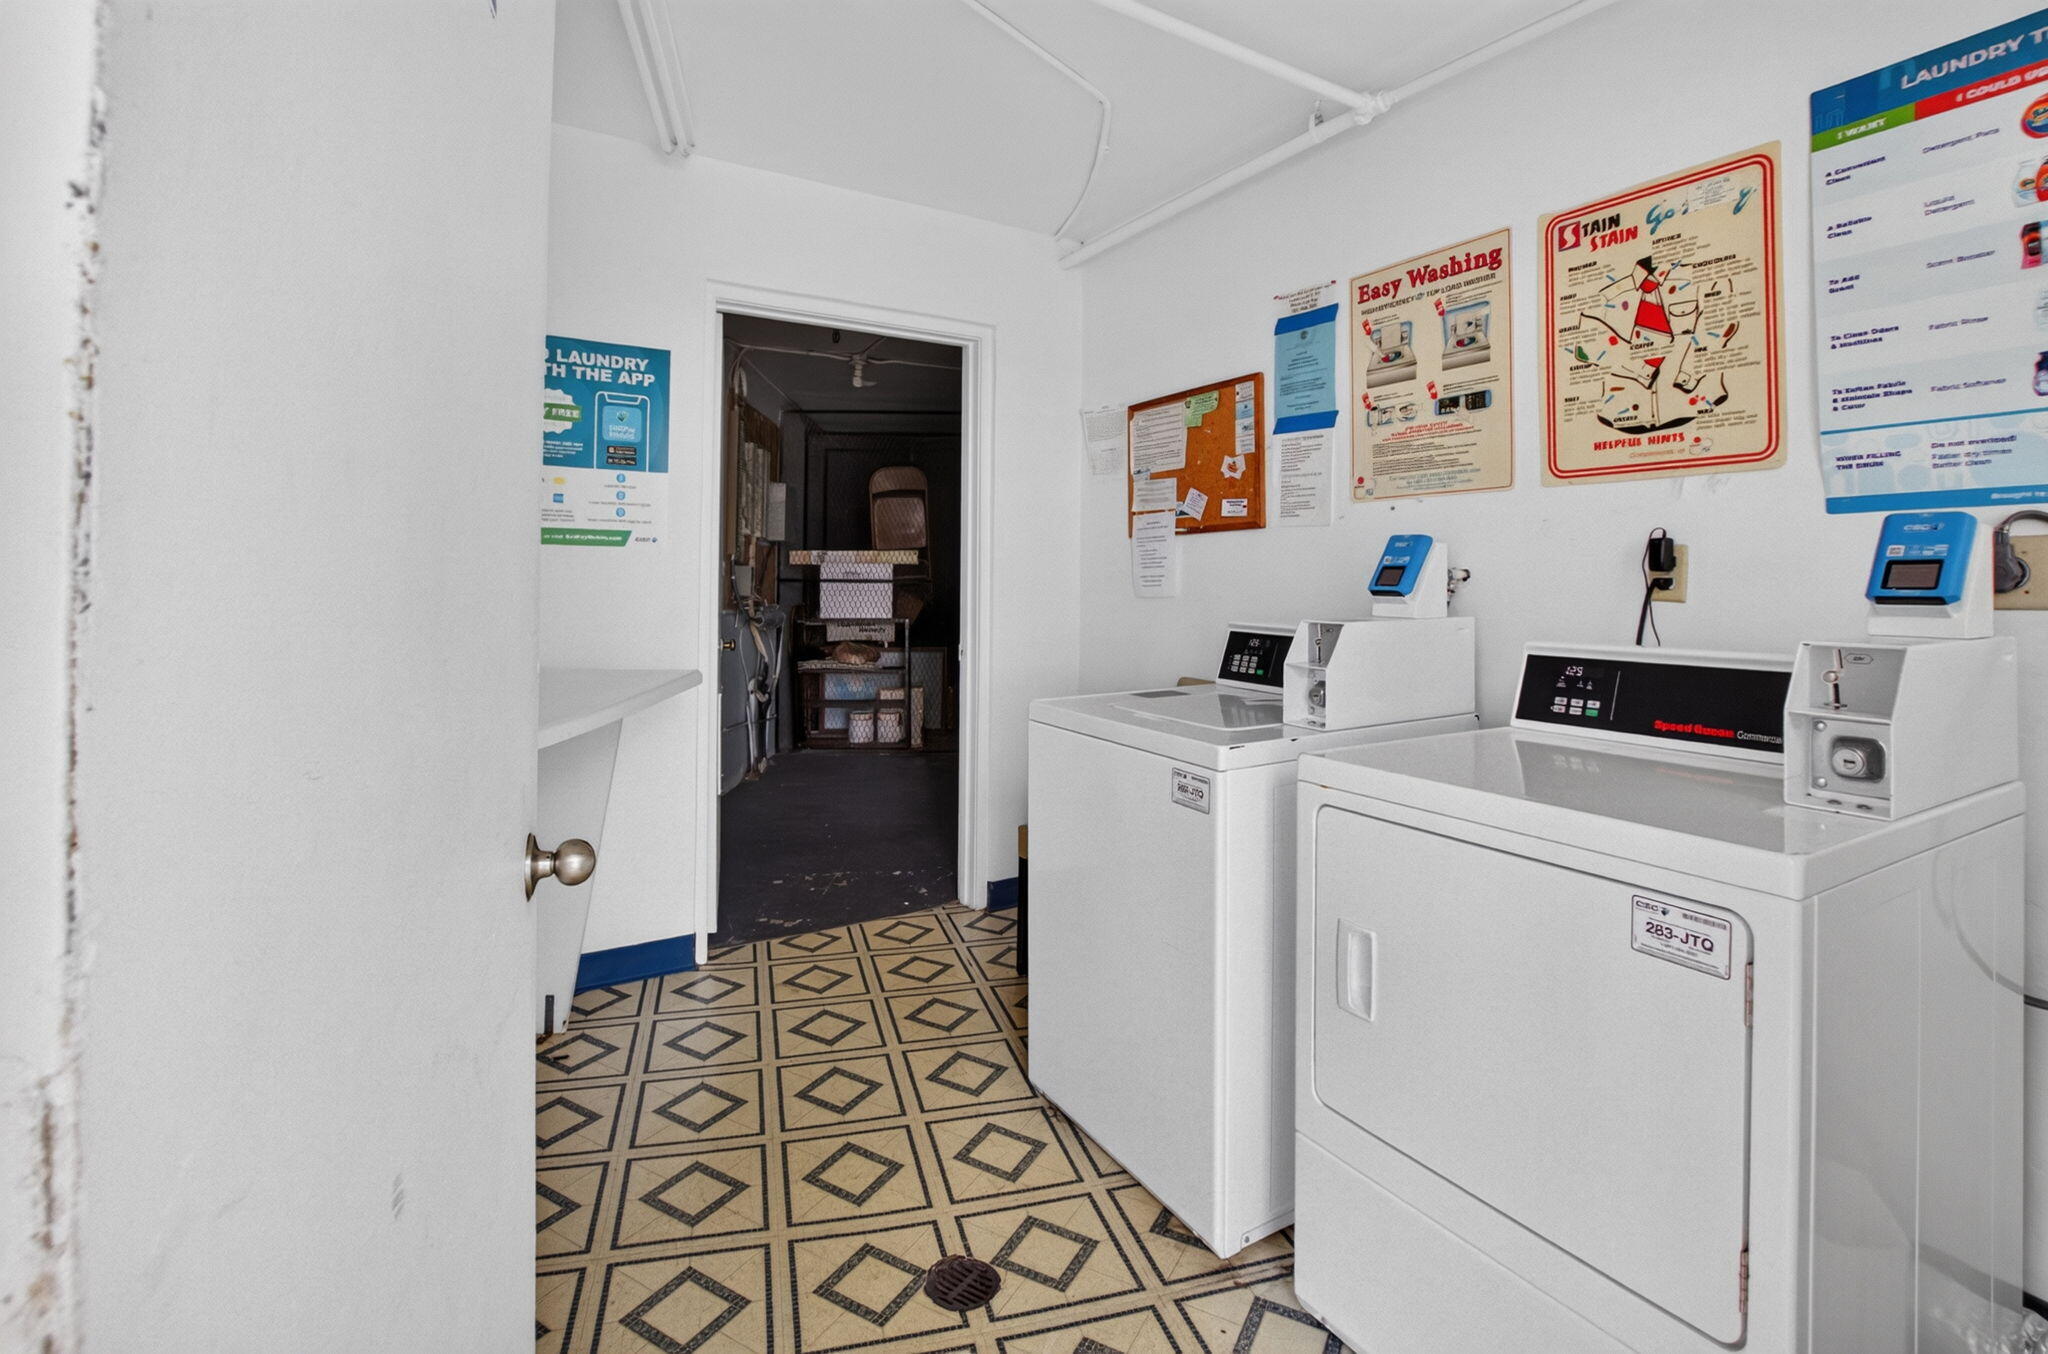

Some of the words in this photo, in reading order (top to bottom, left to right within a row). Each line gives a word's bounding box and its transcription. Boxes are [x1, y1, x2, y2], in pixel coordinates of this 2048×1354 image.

[1901, 34, 2025, 90] LAUNDRY
[1590, 224, 1638, 253] STAIN
[1357, 278, 1402, 305] Easy
[1406, 247, 1503, 288] Washing
[556, 348, 649, 372] LAUNDRY
[572, 366, 612, 383] THE
[617, 371, 655, 388] APP
[1594, 437, 1642, 451] HELPFUL
[1648, 432, 1685, 445] HINTS
[1653, 719, 1693, 733] Speed
[1694, 723, 1735, 739] Queen
[1645, 921, 1714, 953] 283-JTQ
